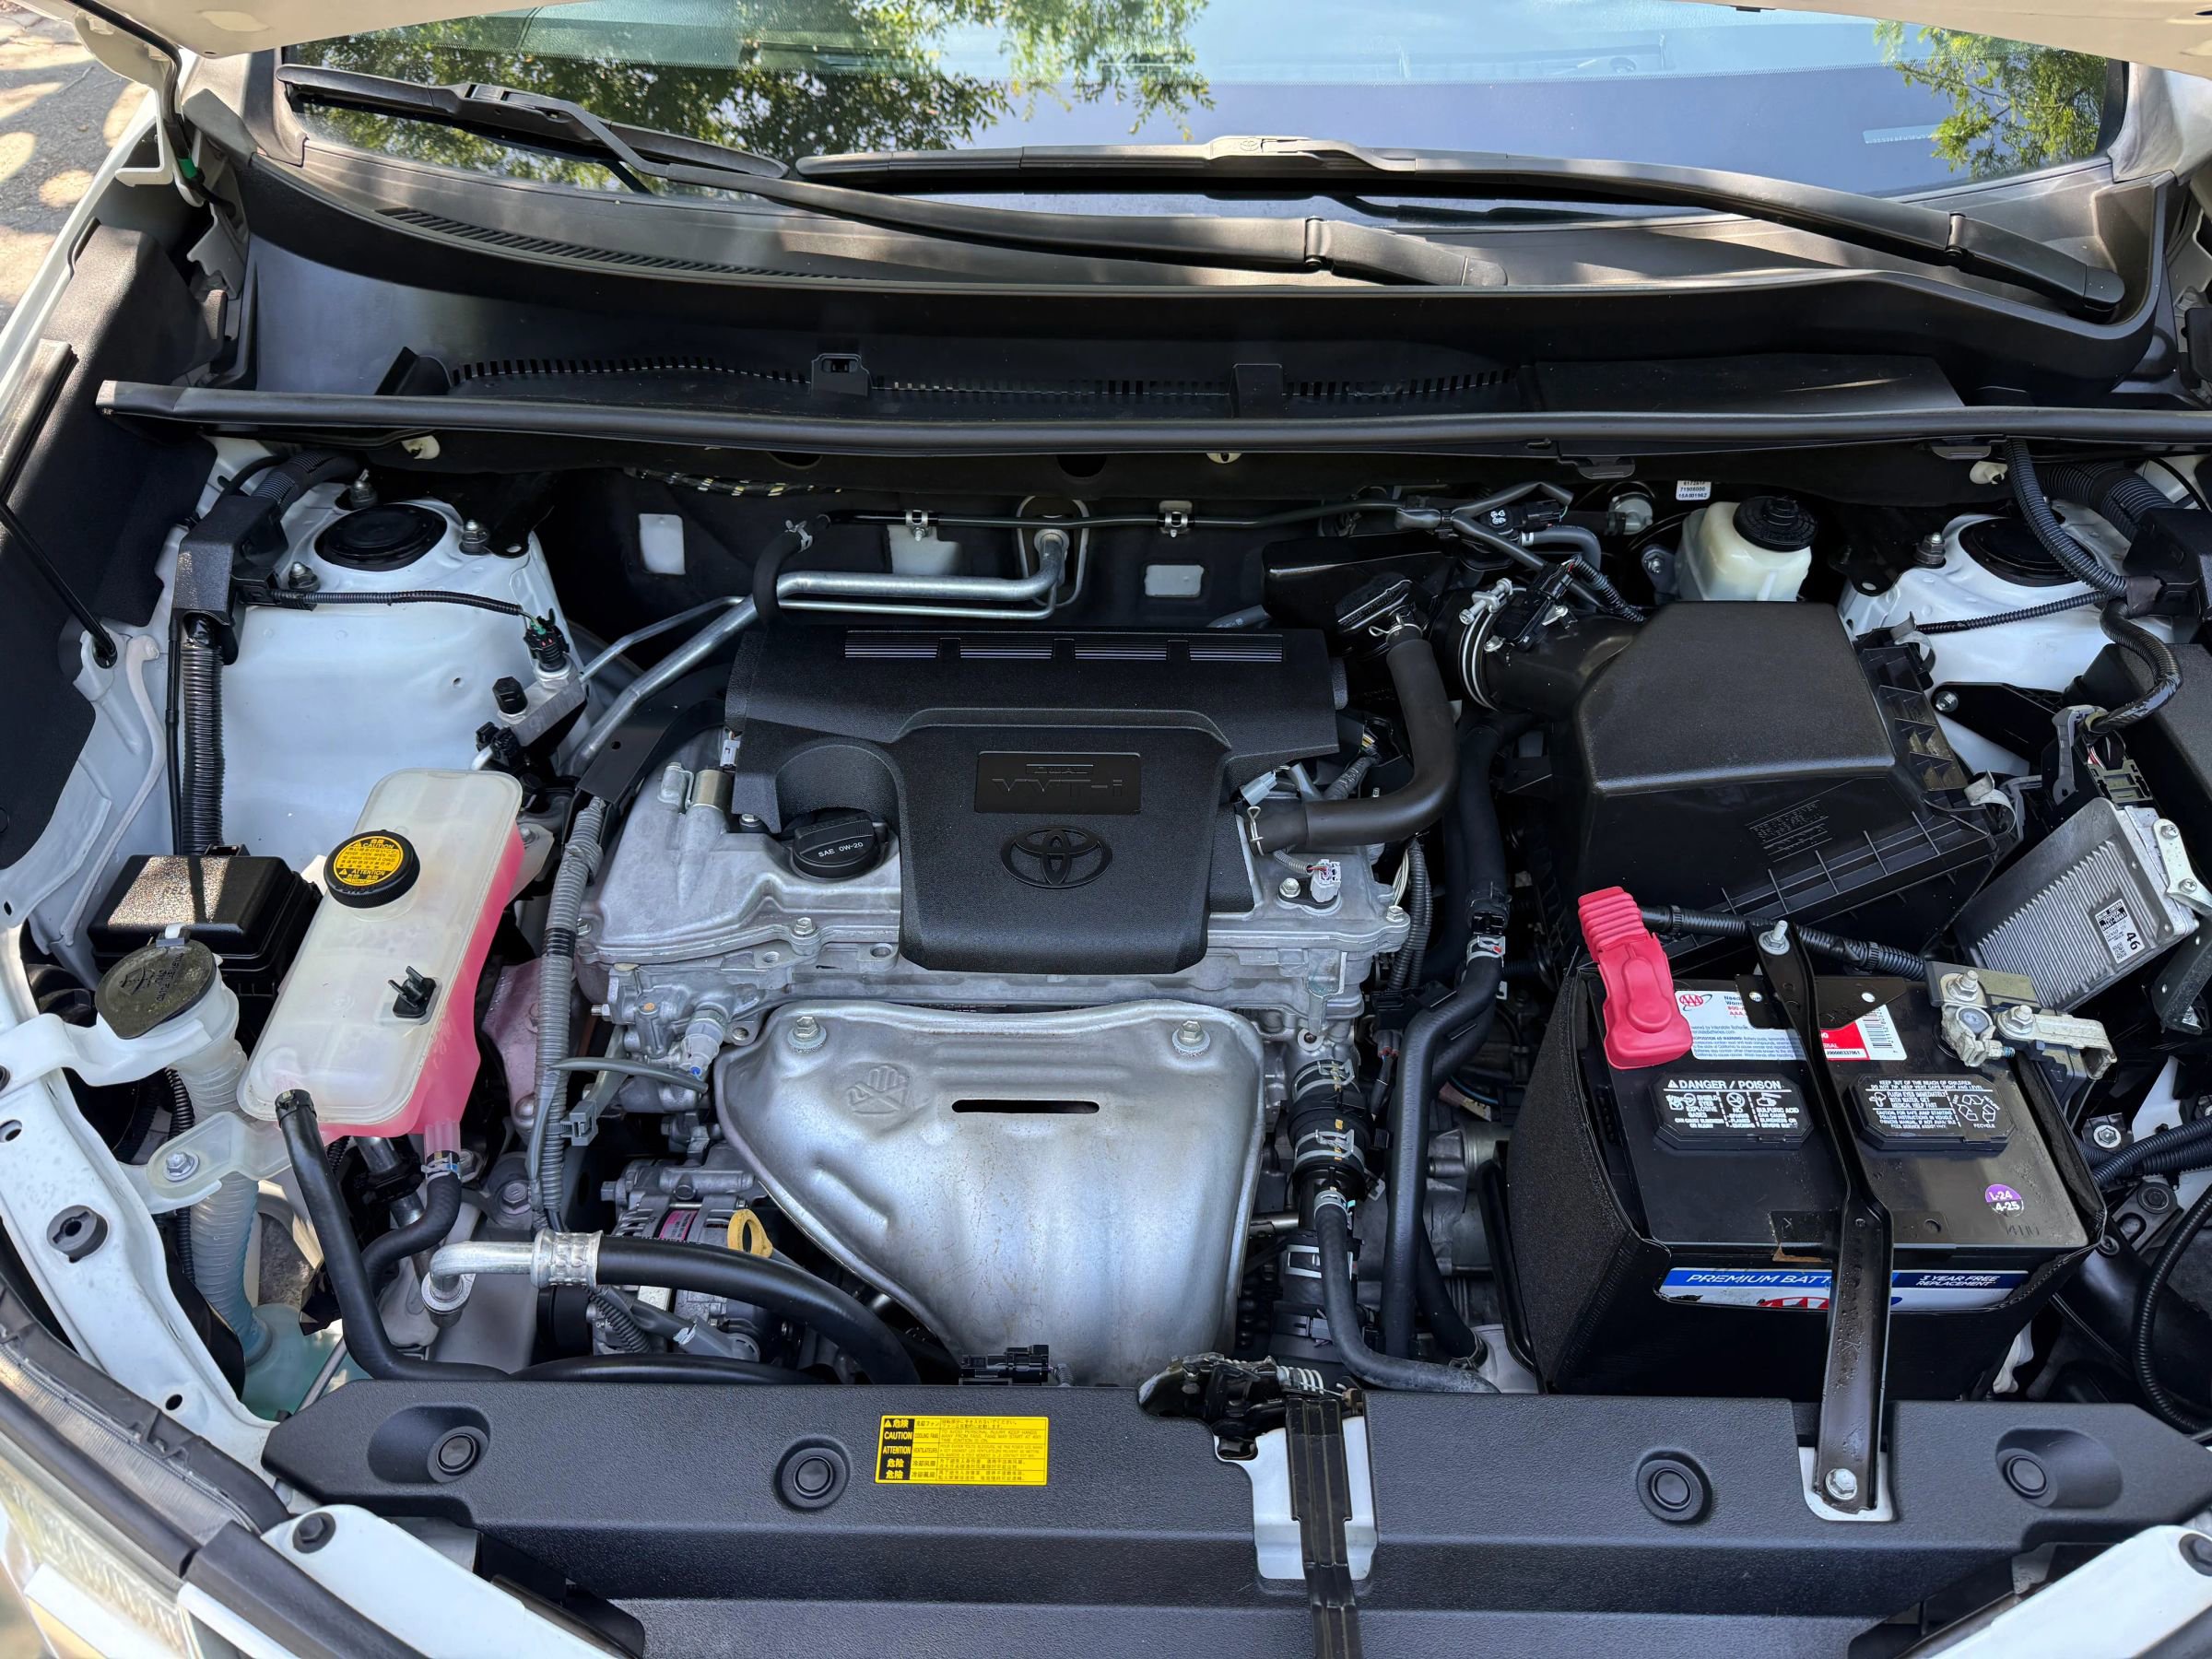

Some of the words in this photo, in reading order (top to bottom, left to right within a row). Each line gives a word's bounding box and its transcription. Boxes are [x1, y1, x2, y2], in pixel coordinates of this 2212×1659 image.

[818, 848, 835, 857] SAE
[839, 841, 864, 853] 0W-20
[2126, 933, 2141, 950] 46
[1678, 994, 1704, 1006] AAA
[1678, 1080, 1727, 1089] DANGER
[1729, 1080, 1735, 1089] /
[1738, 1080, 1782, 1089] POISON
[1995, 1201, 2020, 1211] 4-25
[1686, 1274, 1781, 1283] PREMIUM
[1780, 1275, 1832, 1284] BATT
[884, 1431, 913, 1441] CAUTION
[883, 1445, 912, 1454] ATTENTION
